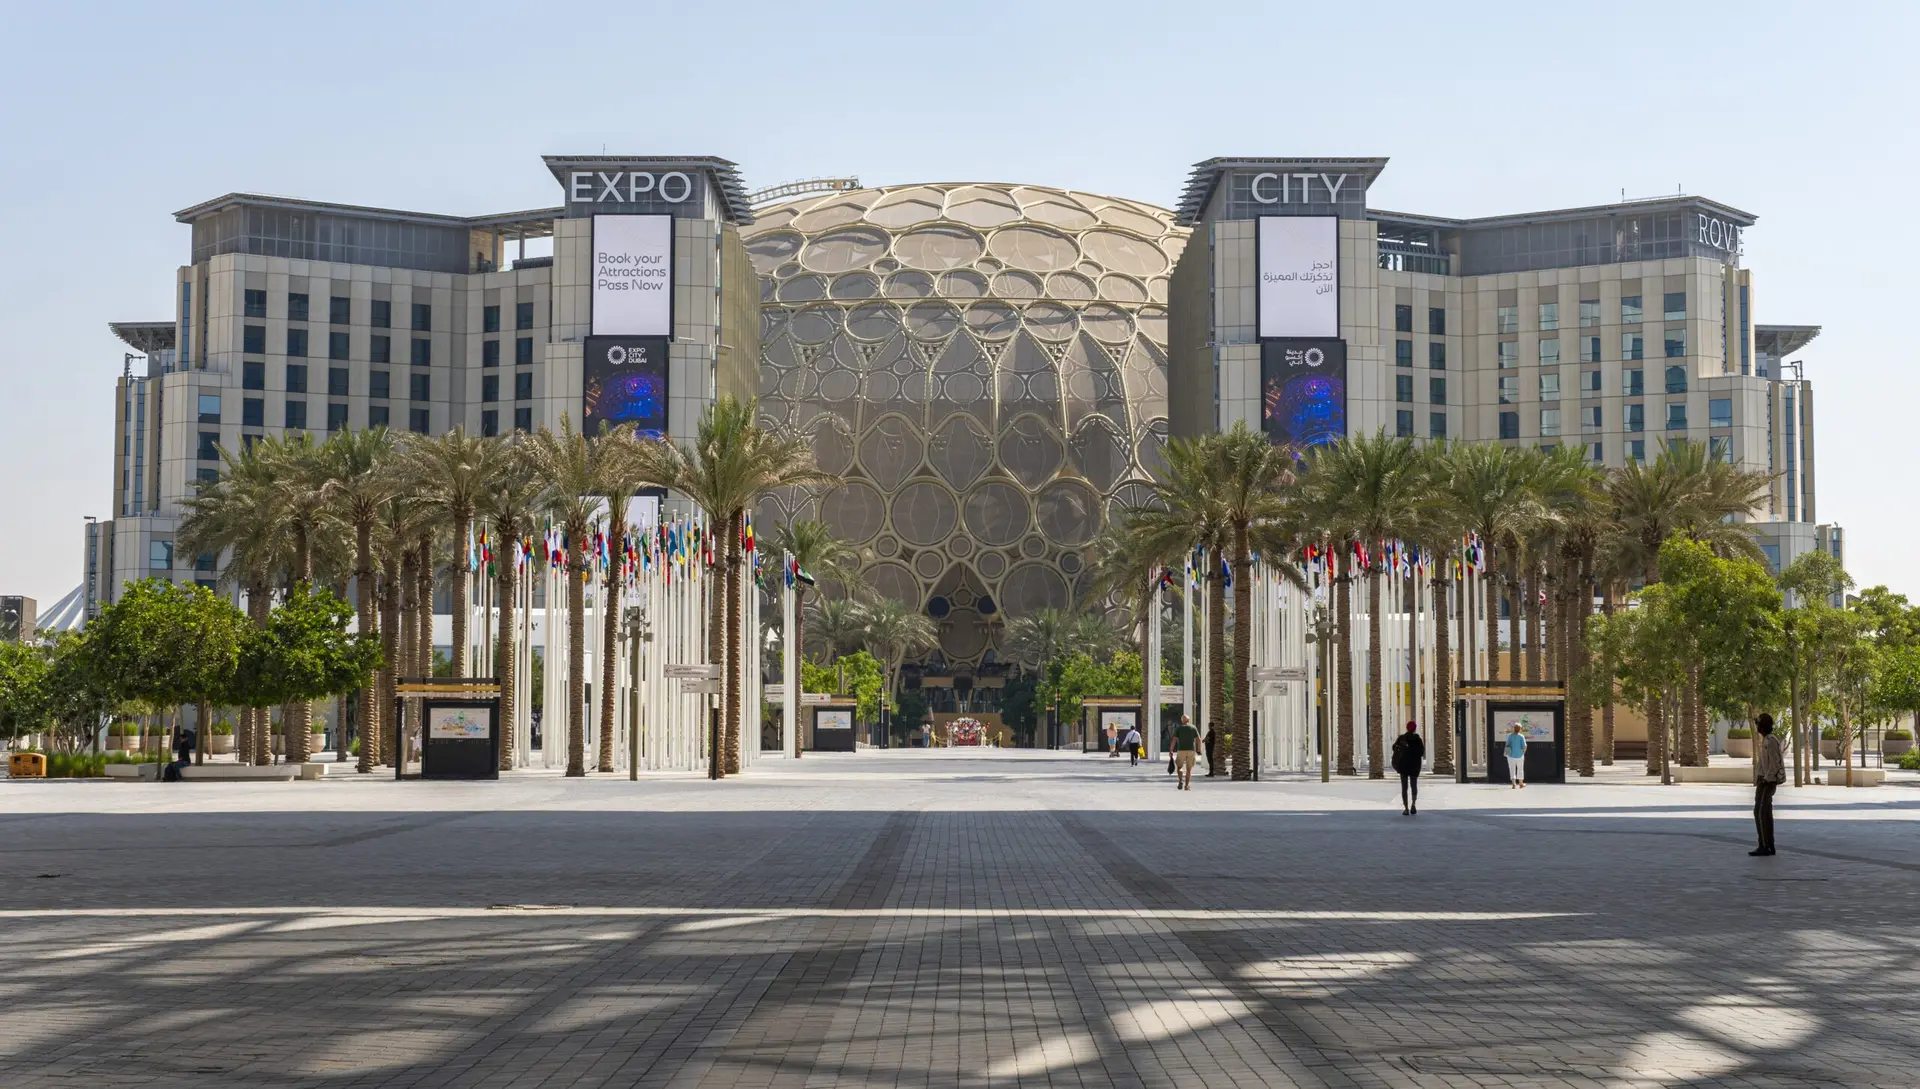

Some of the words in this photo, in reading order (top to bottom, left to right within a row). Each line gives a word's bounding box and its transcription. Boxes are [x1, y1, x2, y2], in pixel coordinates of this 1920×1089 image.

[571, 171, 692, 203] EXPO
[1251, 172, 1348, 204] CITY
[598, 252, 631, 264] Book
[634, 255, 663, 267] your
[1311, 260, 1333, 271] احجز
[598, 265, 667, 278] Attractions
[1263, 272, 1298, 283] المميزة
[1299, 272, 1333, 283] تذكرتك
[598, 279, 629, 291] Pass
[631, 279, 664, 291] Now
[1315, 284, 1333, 295] الآن
